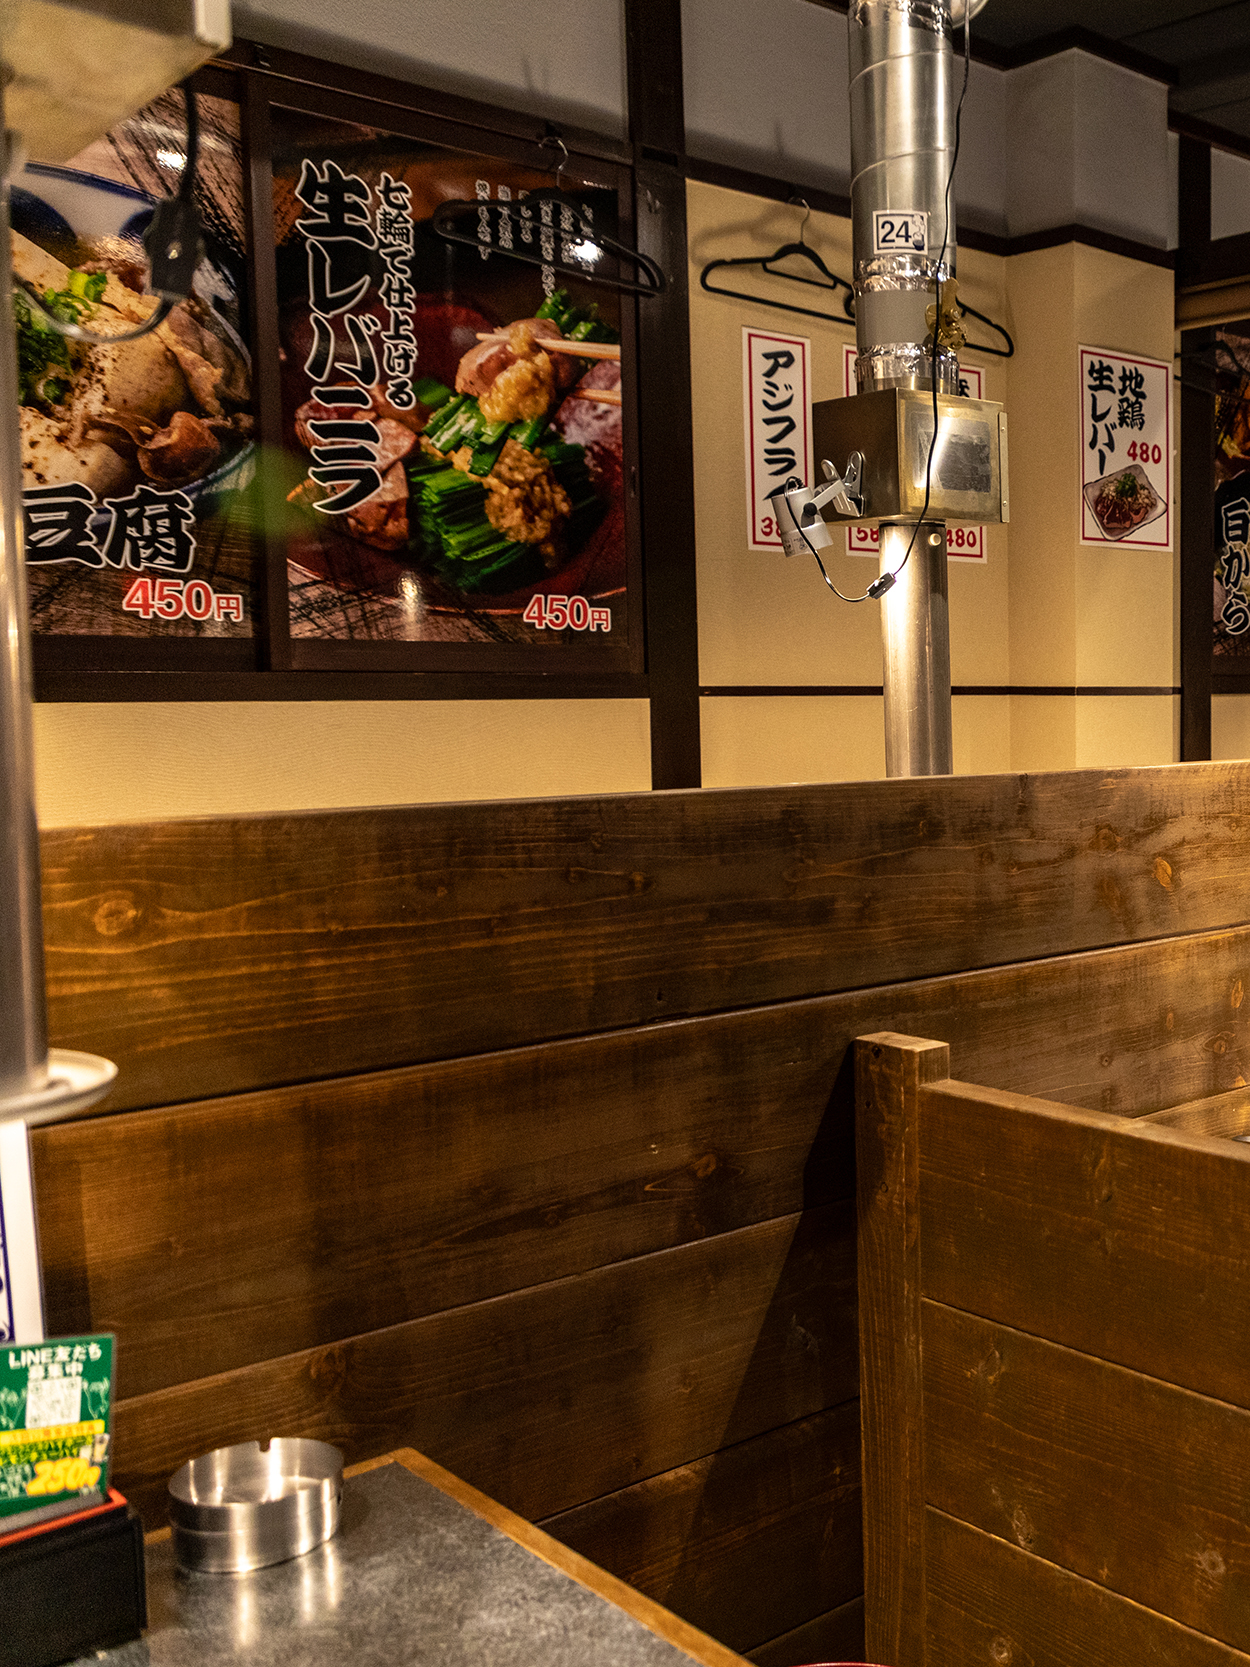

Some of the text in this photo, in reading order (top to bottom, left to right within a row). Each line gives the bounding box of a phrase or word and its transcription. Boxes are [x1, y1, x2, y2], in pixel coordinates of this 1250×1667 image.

[881, 220, 912, 243] 24
[295, 158, 384, 516] 生レバニラ
[1087, 360, 1116, 476] 生レバー
[1118, 365, 1148, 431] 地鶏
[1127, 440, 1162, 465] 480
[22, 480, 197, 573] 豆腐
[856, 526, 880, 543] 58
[122, 577, 244, 622] 450円
[523, 594, 611, 631] 450円
[9, 1344, 101, 1369] LINE友だち
[26, 1456, 101, 1496] 250円
